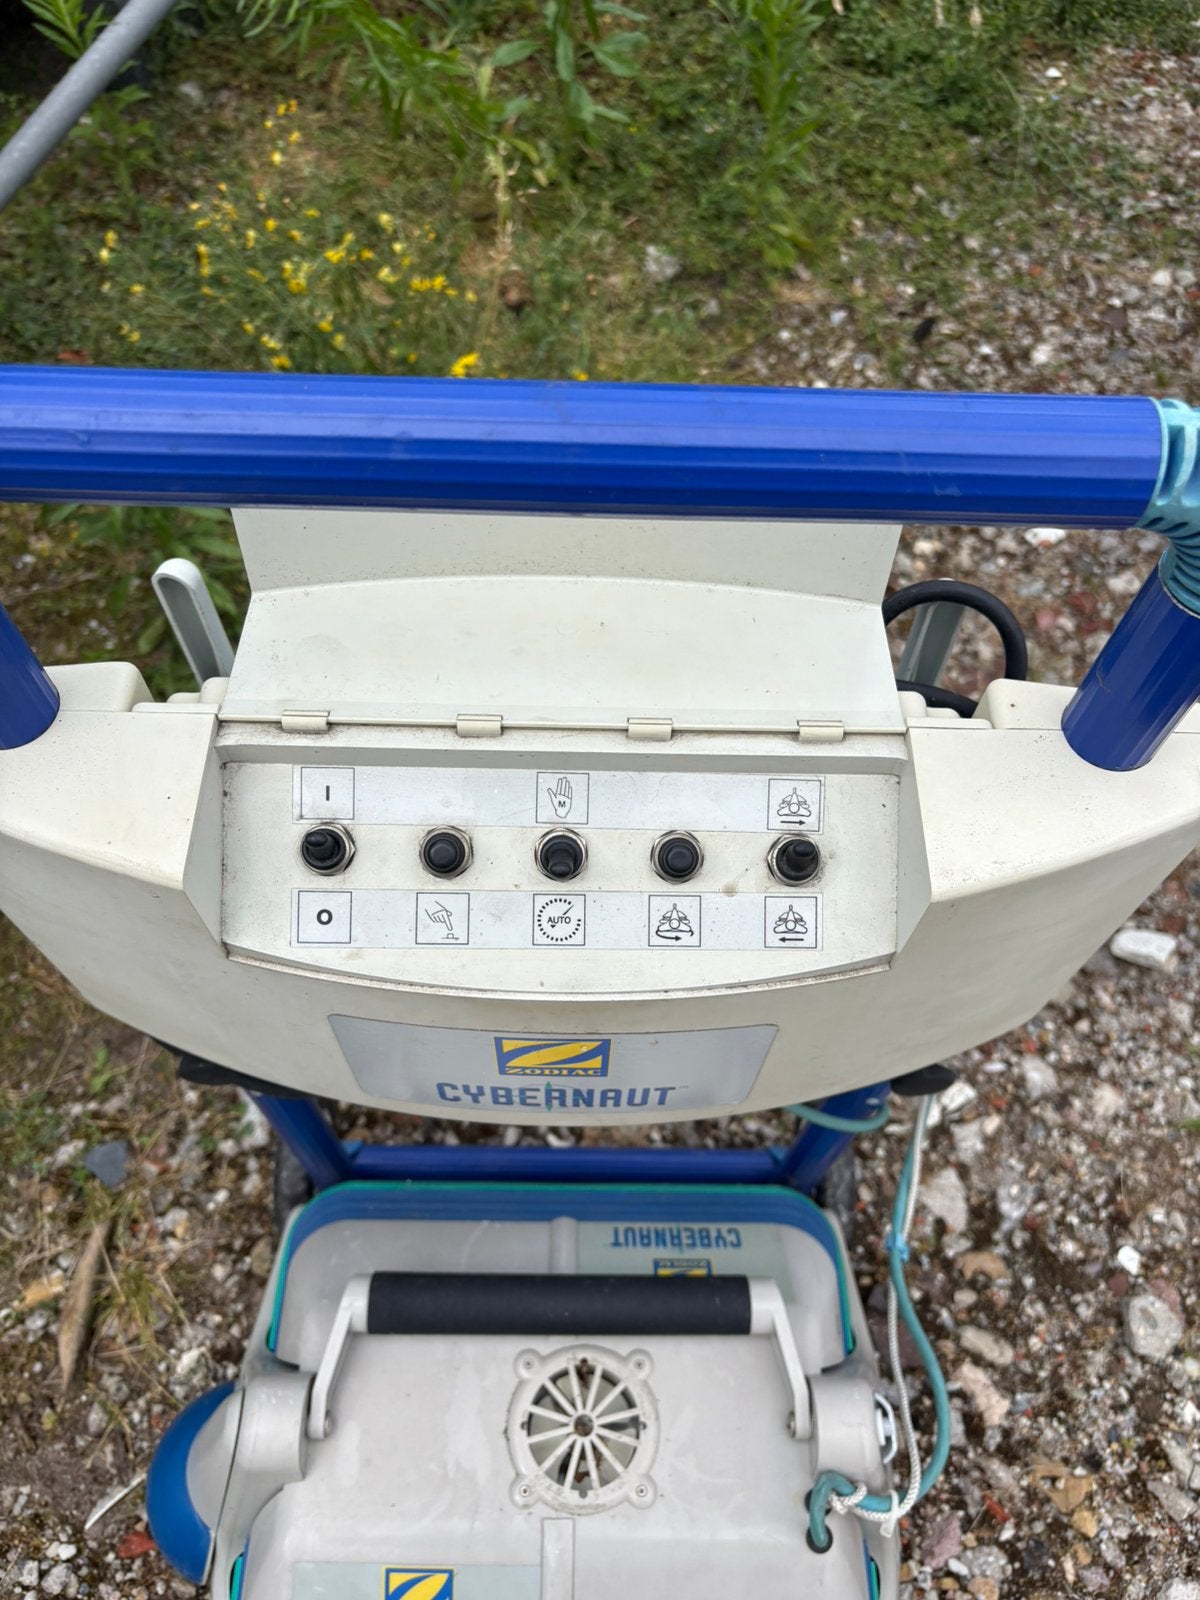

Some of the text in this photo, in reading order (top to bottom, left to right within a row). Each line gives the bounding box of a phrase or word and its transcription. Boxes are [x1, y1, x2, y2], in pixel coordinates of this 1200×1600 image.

[558, 800, 566, 808] M
[547, 916, 571, 924] AUTO
[504, 1067, 601, 1076] ZODIAC
[436, 1082, 676, 1108] CYBERNAUT
[610, 1226, 742, 1248] CYBERNAUT
